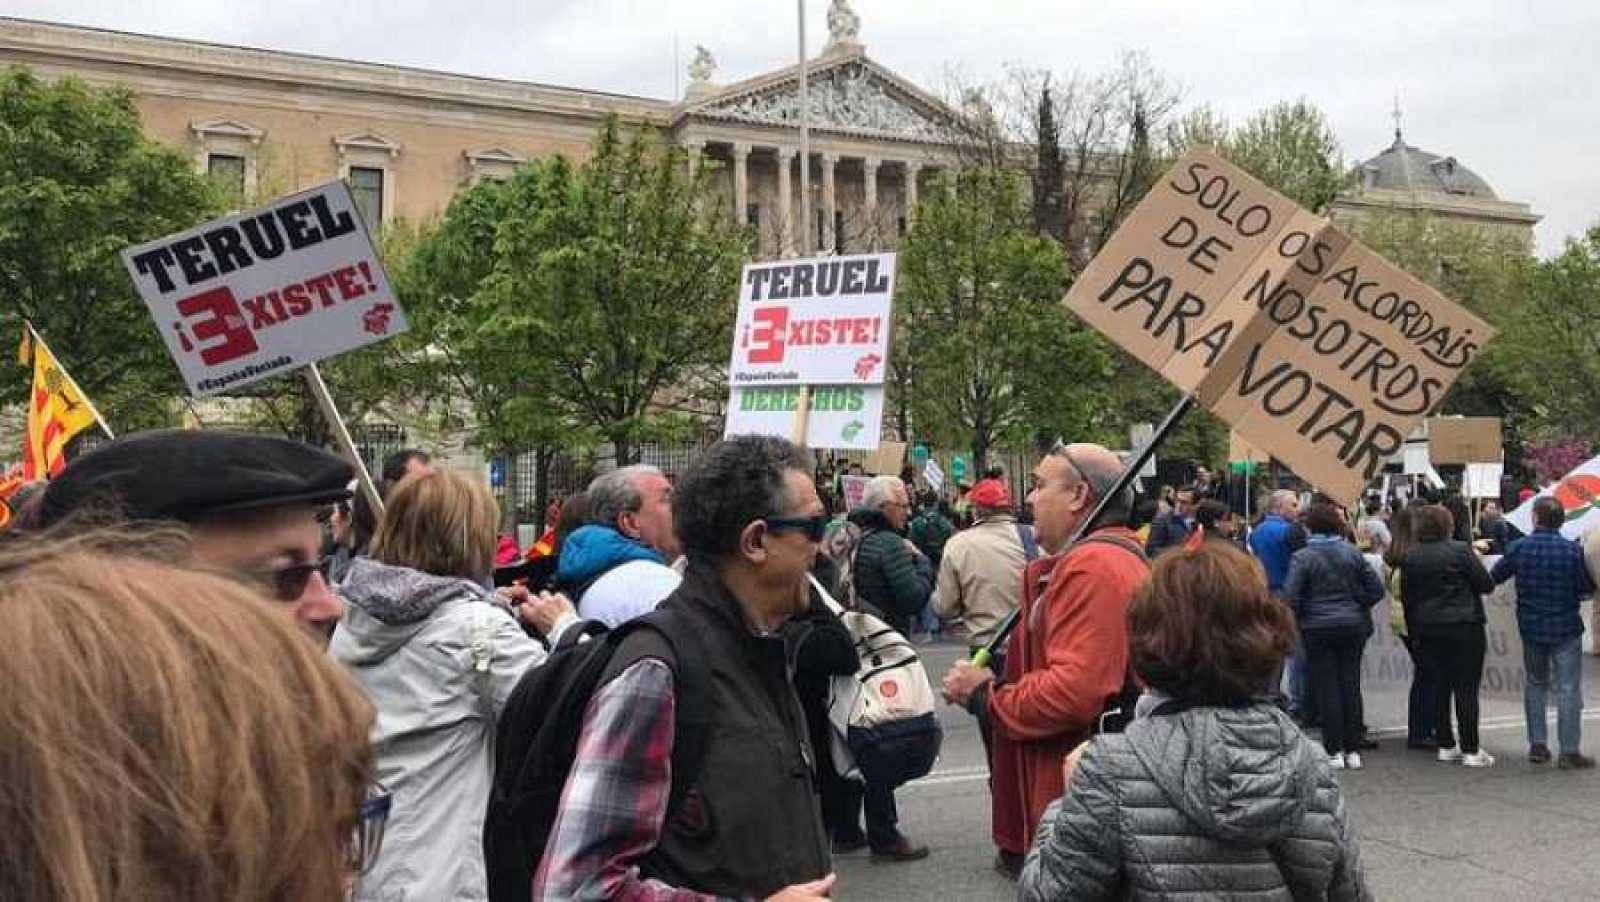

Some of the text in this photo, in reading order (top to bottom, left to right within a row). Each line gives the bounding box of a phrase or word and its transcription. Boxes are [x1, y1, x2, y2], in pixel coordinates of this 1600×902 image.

[131, 194, 356, 295] TERUEL
[1170, 162, 1271, 238] SOLO
[1278, 230, 1332, 276] OS
[747, 259, 890, 302] TERUEL
[1160, 216, 1442, 417] DE NOSOTROS
[740, 386, 865, 411] DEREHOS
[1098, 256, 1401, 482] PARA VOTAR
